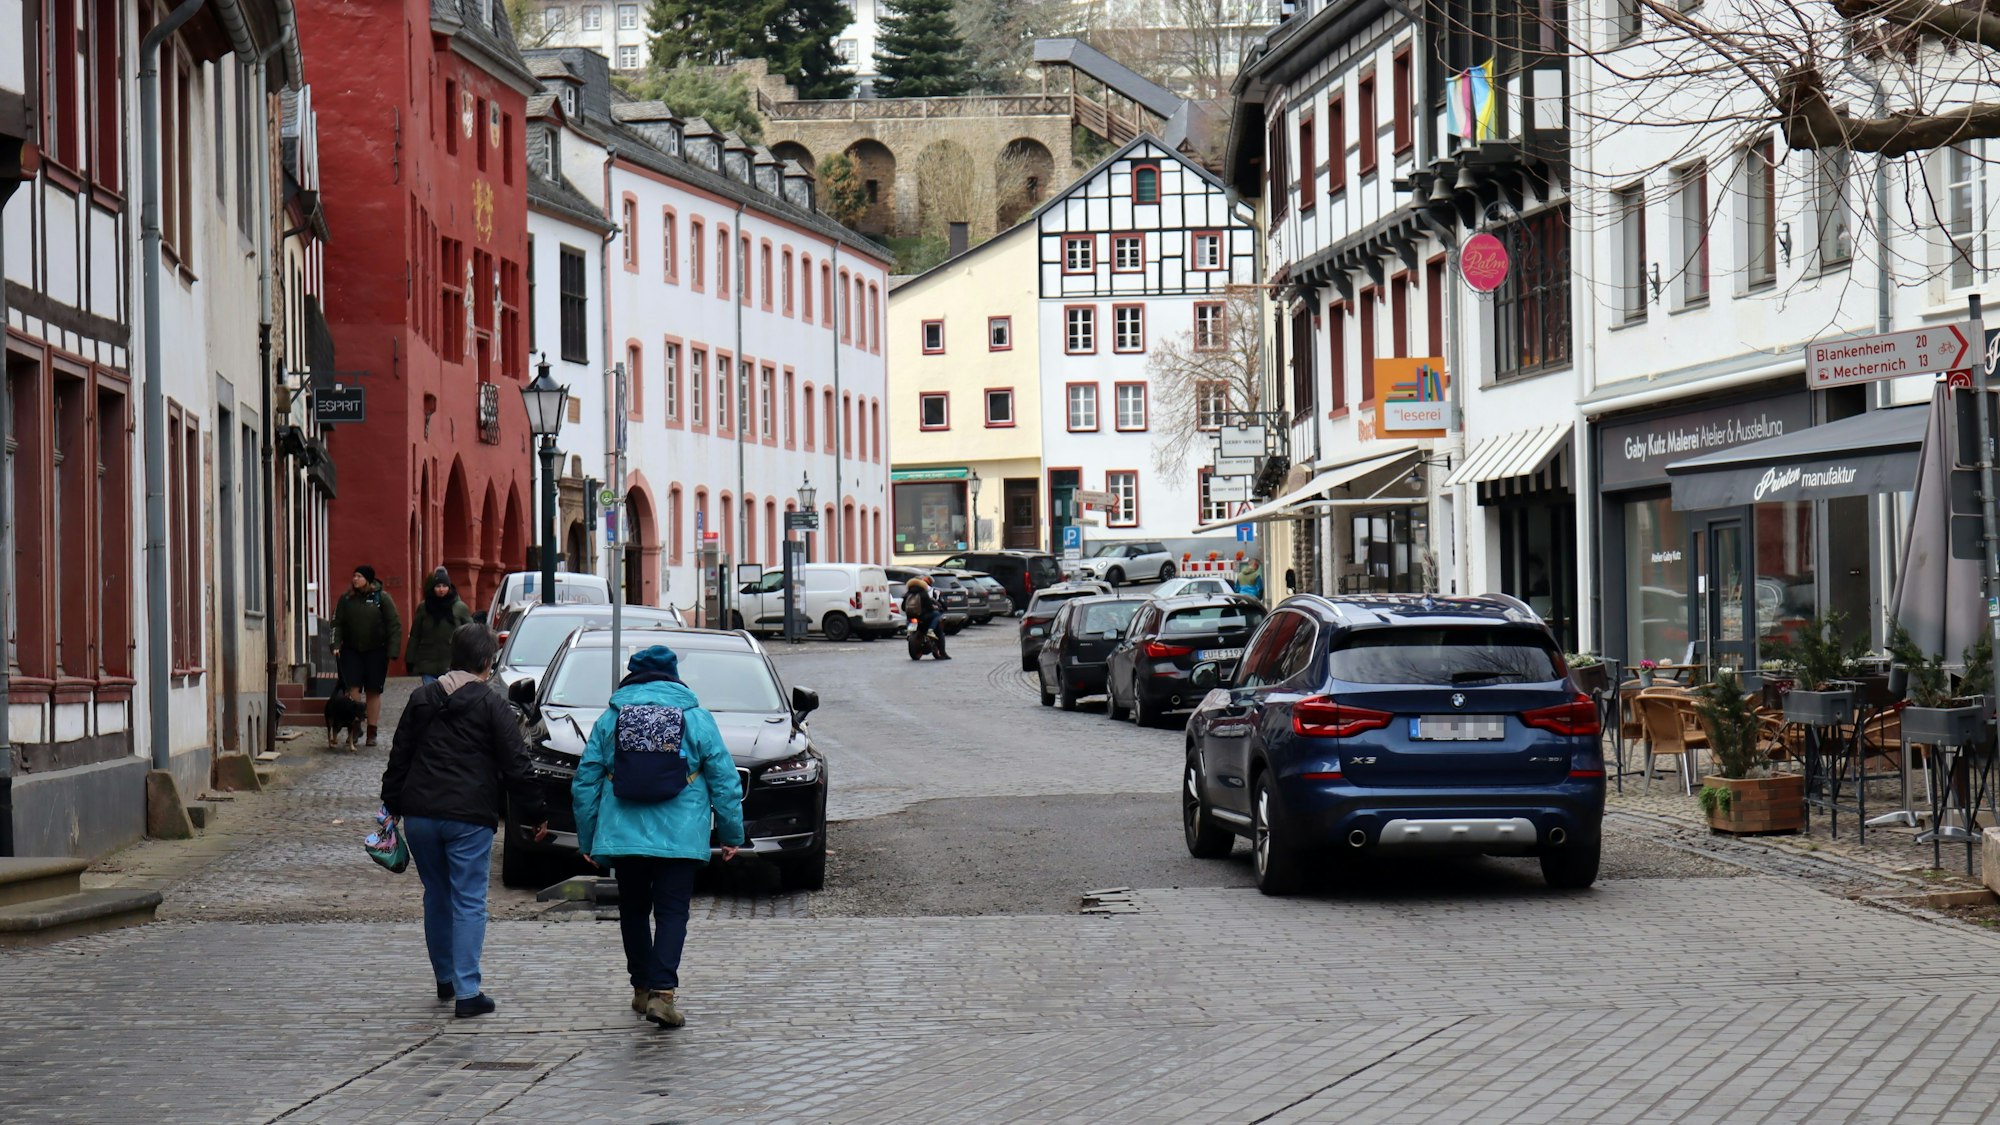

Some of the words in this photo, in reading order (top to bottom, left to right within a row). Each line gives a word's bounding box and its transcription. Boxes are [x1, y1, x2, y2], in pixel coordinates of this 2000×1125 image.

[1464, 250, 1505, 273] Palm
[1816, 341, 1896, 362] Blankenheim
[1916, 334, 1928, 349] 20
[1833, 357, 1906, 379] Mechernich
[1918, 354, 1929, 367] 13
[318, 400, 361, 412] ESPRIT
[1400, 408, 1441, 421] leserei
[1624, 436, 1647, 462] Gaby
[1648, 433, 1667, 456] Kutz
[1667, 427, 1699, 453] Malerei
[1700, 423, 1726, 447] Atelier
[1726, 419, 1735, 443] &
[1735, 413, 1783, 442] Ausstellung
[1753, 466, 1800, 500] Printen
[1801, 466, 1857, 487] manufaktur
[1067, 529, 1077, 545] P
[1349, 756, 1377, 764] X3
